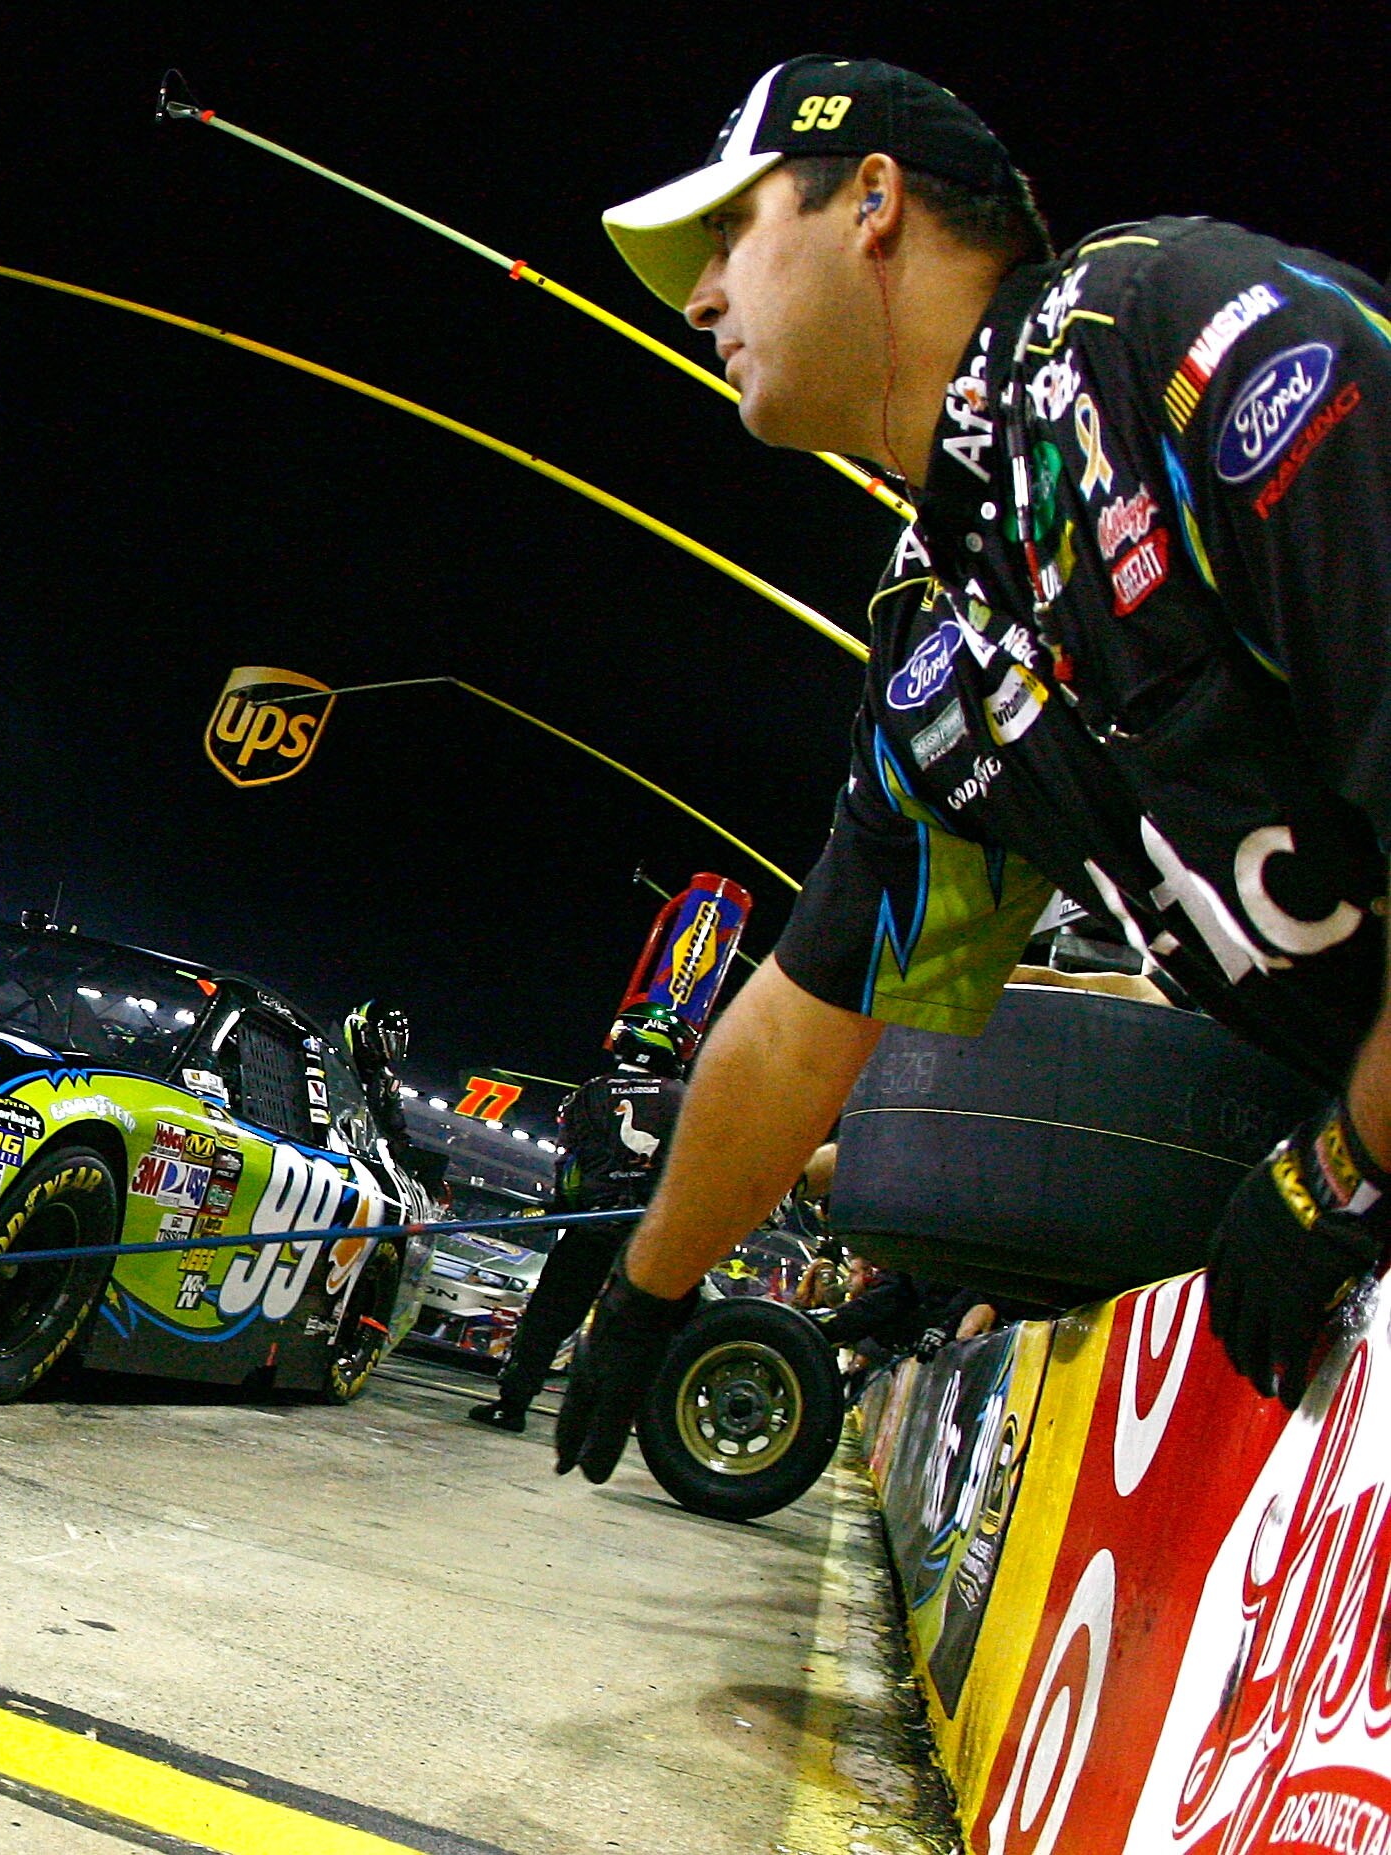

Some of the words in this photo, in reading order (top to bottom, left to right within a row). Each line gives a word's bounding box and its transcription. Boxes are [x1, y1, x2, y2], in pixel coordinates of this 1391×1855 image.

[791, 95, 852, 132] 99
[1189, 284, 1280, 378] NASCAR
[1234, 361, 1312, 458] Ford
[1252, 381, 1361, 520] RACING
[907, 638, 950, 699] Ford
[216, 696, 316, 767] ups
[671, 903, 719, 1001] SUNOCO
[454, 1076, 523, 1121] 77
[131, 1155, 167, 1197] 3M
[218, 1143, 343, 1320] 99
[1269, 1790, 1391, 1855] DISINFECTA
